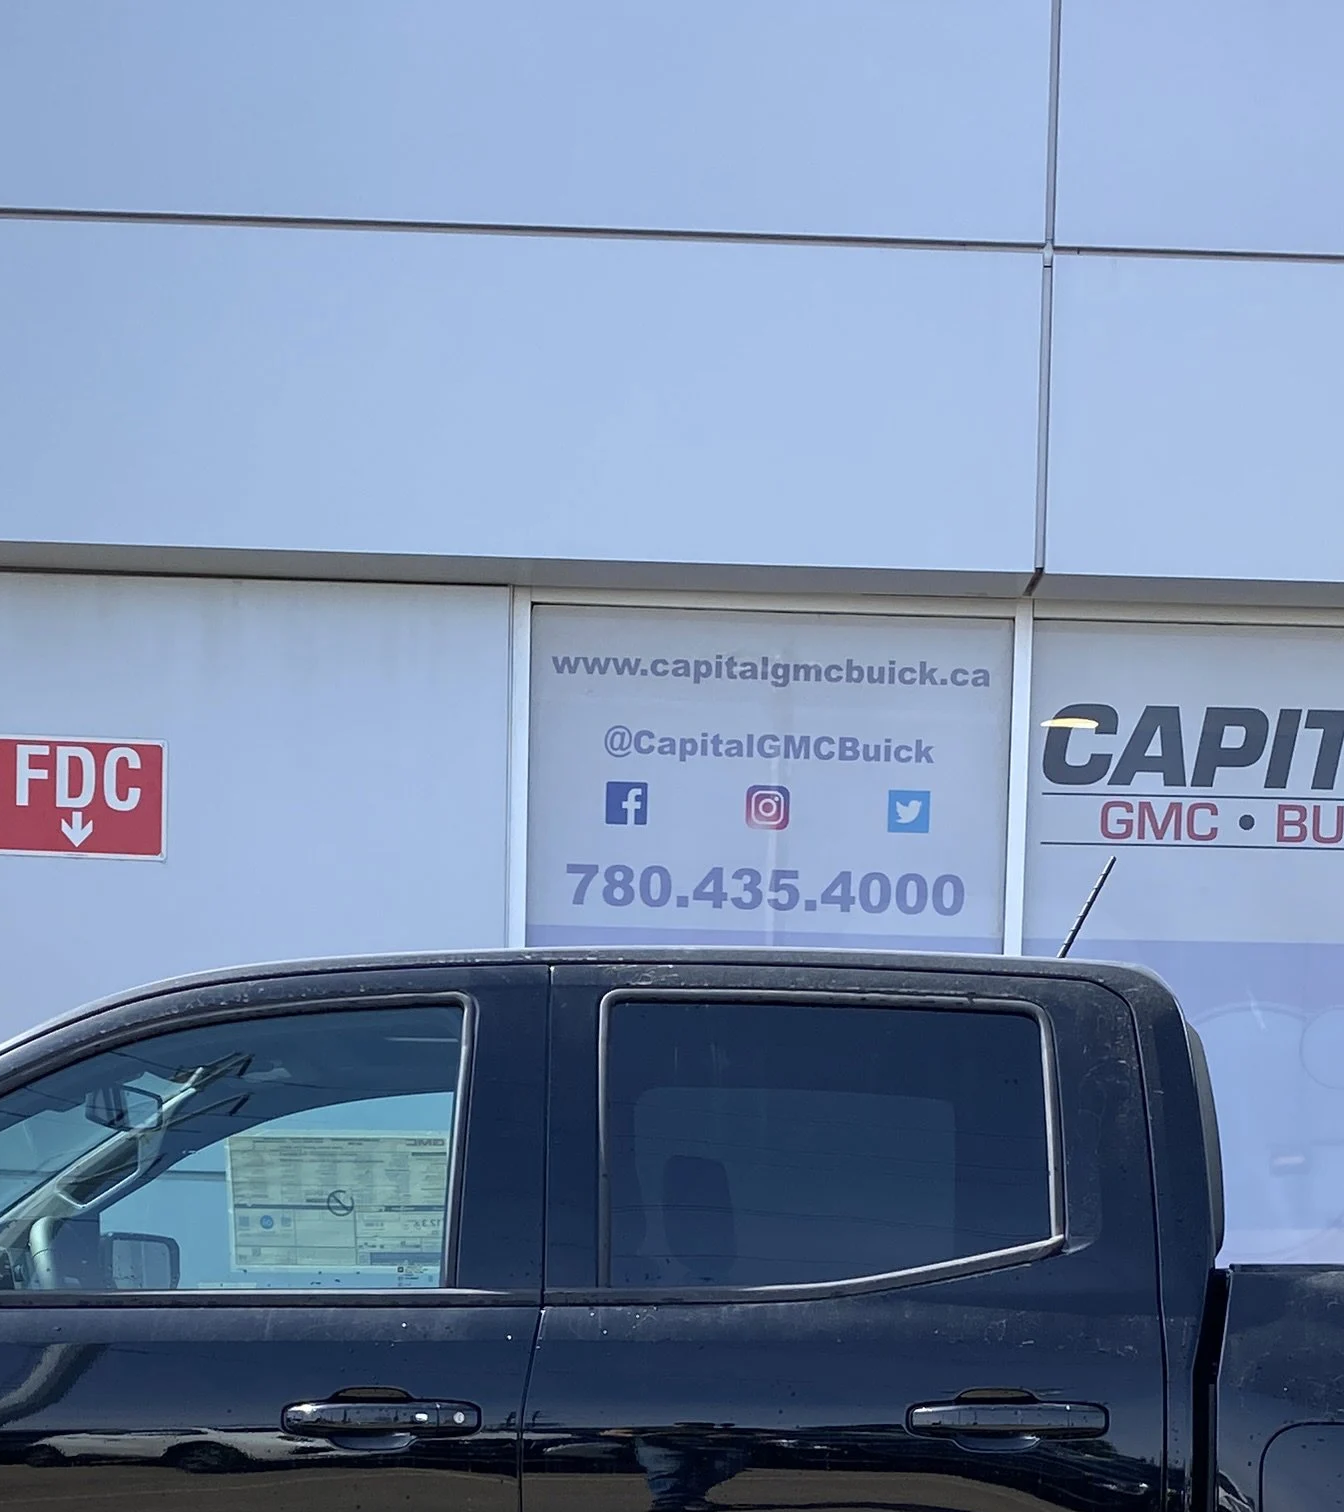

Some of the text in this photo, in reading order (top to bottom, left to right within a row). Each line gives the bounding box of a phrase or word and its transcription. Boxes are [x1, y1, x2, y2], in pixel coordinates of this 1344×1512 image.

[551, 655, 991, 688] www.capitalgmcbuick.ca
[604, 724, 936, 765] @CapitalGMCBuick
[15, 743, 142, 812] FDC
[1100, 801, 1219, 842] GMC
[566, 863, 966, 917] 780.435.4000
